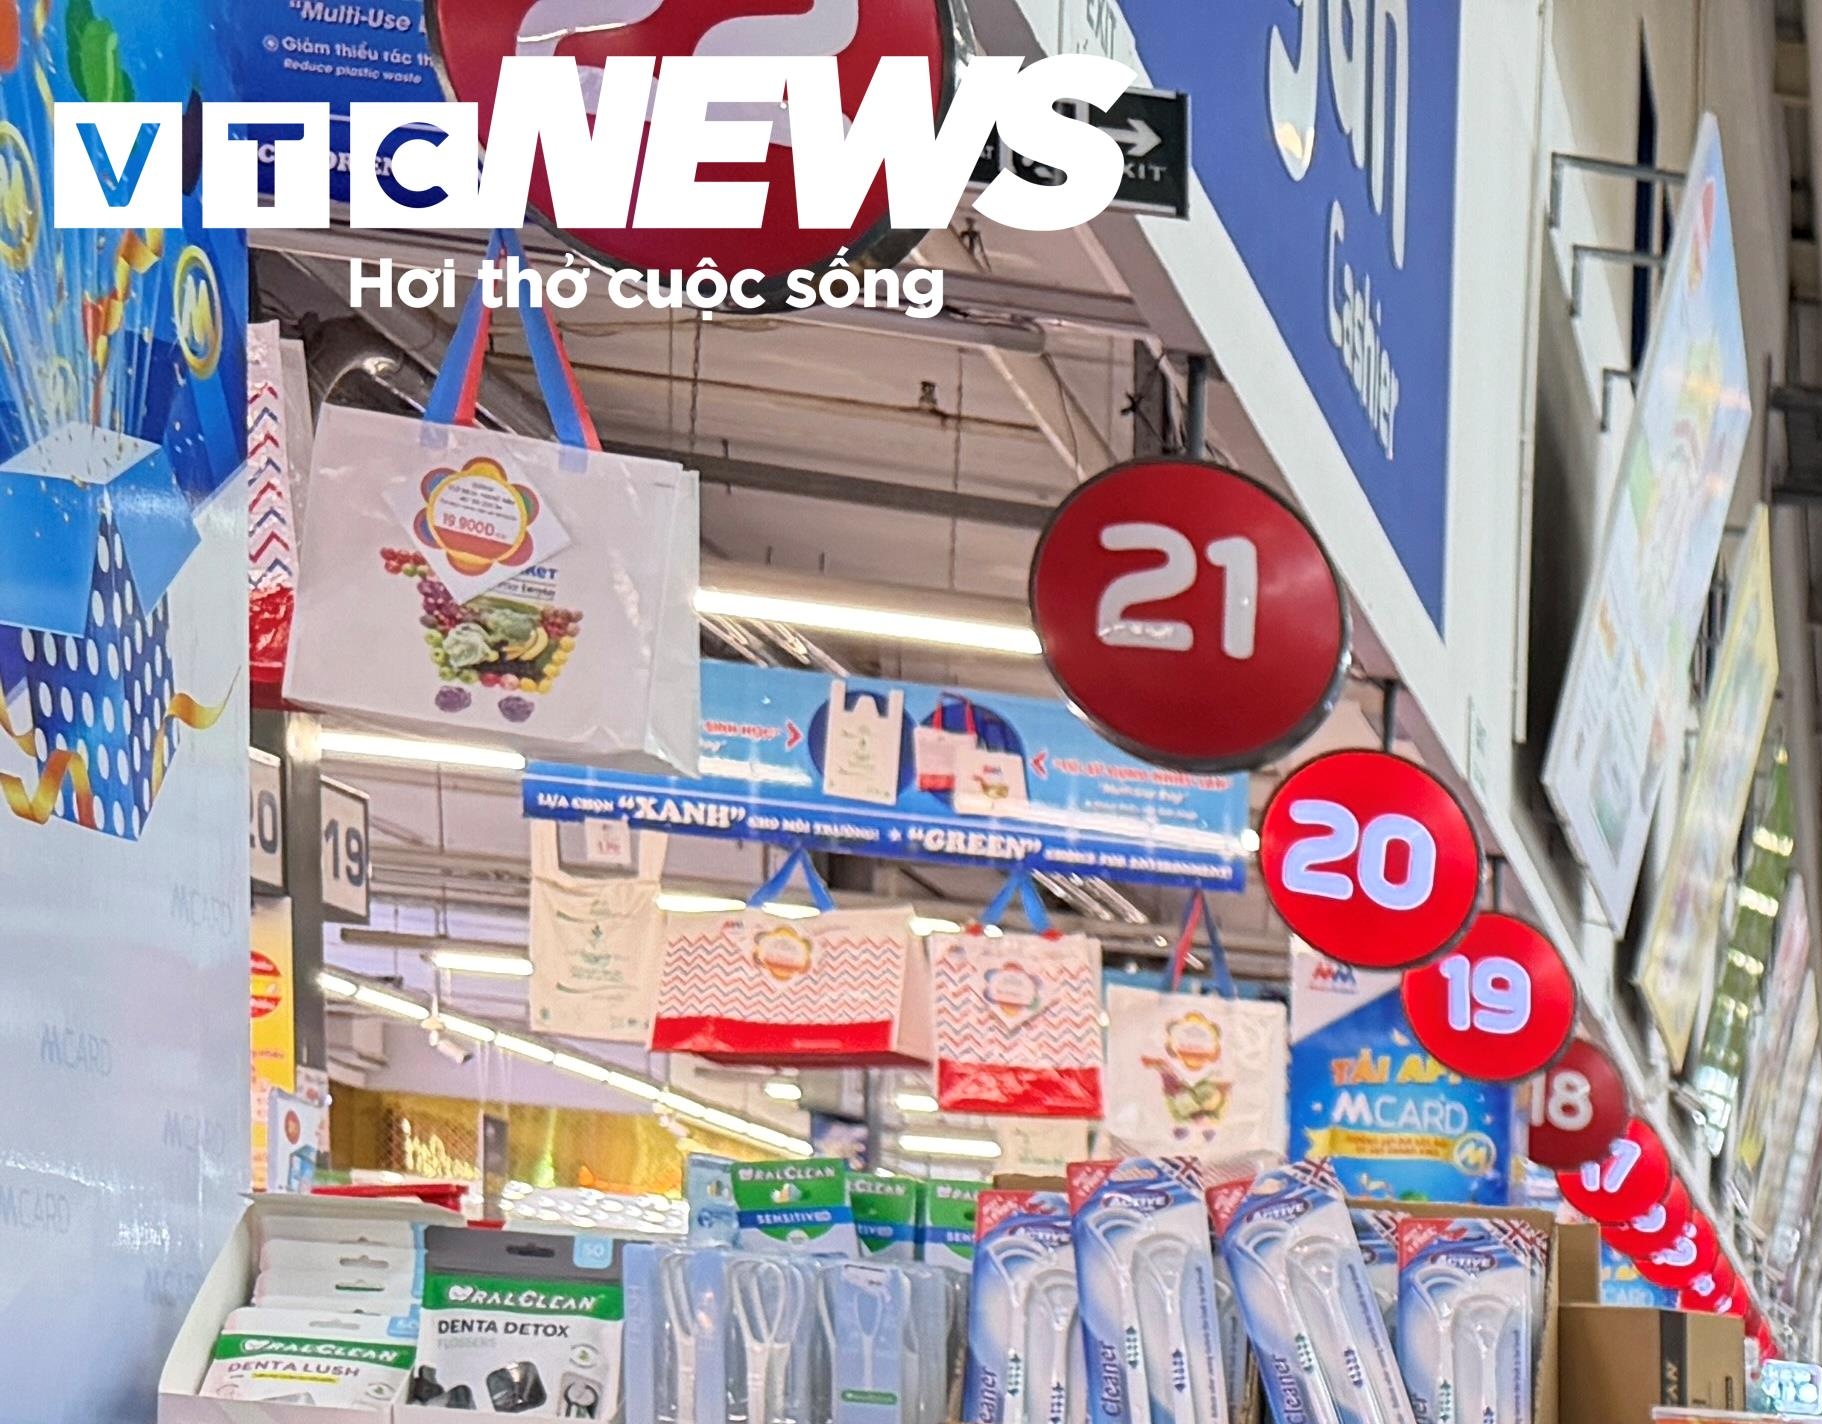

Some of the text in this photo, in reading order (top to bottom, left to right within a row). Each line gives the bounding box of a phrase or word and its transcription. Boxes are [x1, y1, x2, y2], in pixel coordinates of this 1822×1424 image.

[283, 57, 423, 85] Reduce plastic waste
[1120, 162, 1167, 183] XIT
[1328, 199, 1400, 461] Cashier
[1096, 521, 1260, 661] 21
[250, 789, 279, 856] 0
[323, 817, 366, 887] 19
[1282, 798, 1437, 912] 20
[1438, 954, 1532, 1035] 19
[1331, 1090, 1469, 1137] MCARD
[1530, 1070, 1594, 1132] 18
[437, 1318, 570, 1338] DENTA DETOX
[227, 1359, 361, 1378] DENTA LUSH
